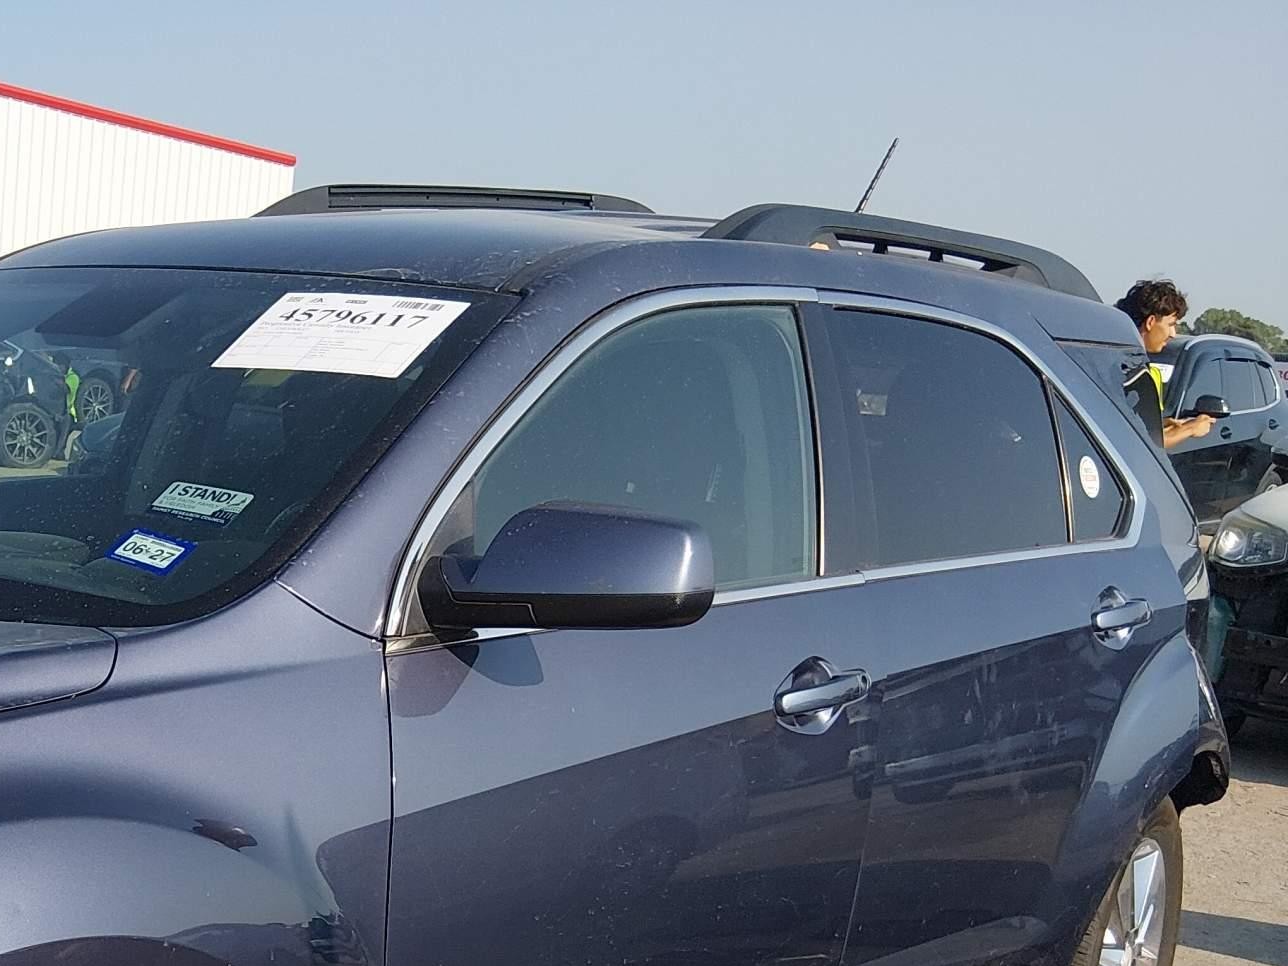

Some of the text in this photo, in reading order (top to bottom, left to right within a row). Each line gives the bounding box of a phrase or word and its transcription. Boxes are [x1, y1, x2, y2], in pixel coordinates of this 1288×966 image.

[279, 307, 428, 328] 45796117
[169, 484, 180, 494] I
[177, 486, 237, 504] STAND!
[123, 541, 148, 555] 06
[148, 549, 177, 563] 27
